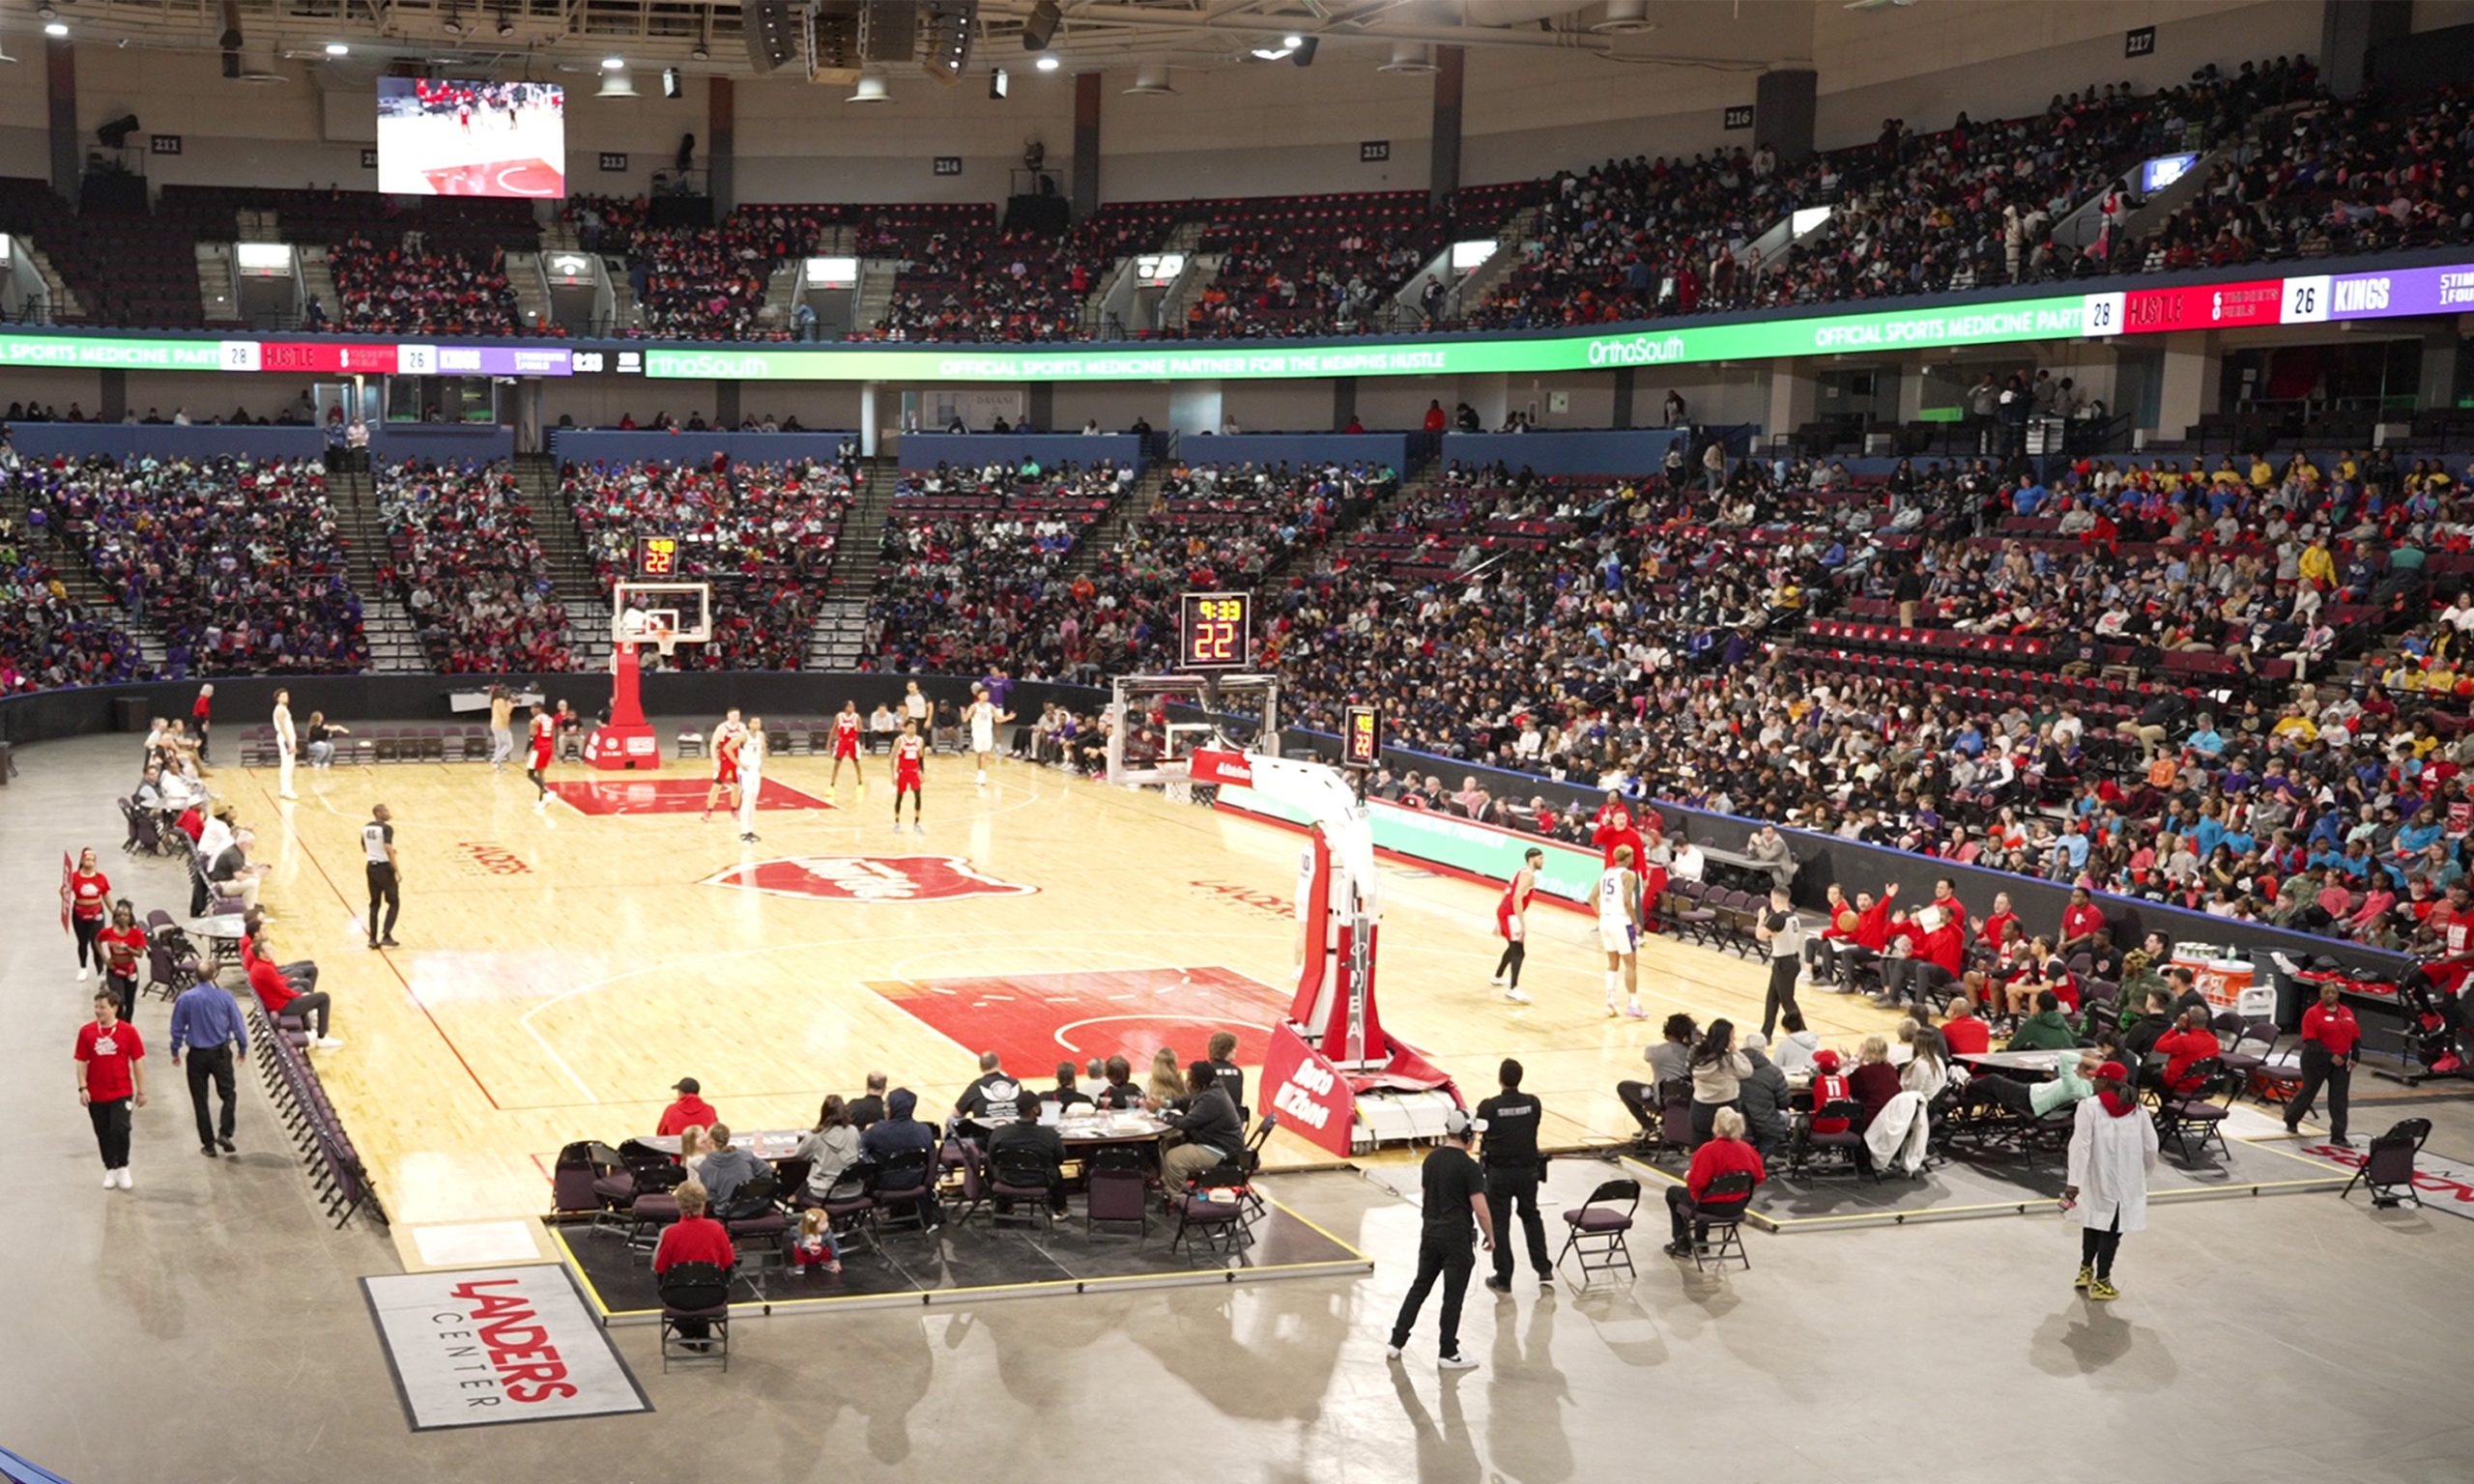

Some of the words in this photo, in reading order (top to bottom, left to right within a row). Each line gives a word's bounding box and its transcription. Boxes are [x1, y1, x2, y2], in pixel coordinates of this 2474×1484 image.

[2128, 33, 2152, 52] 217
[1727, 110, 1750, 125] 216
[155, 138, 178, 151] 211
[1364, 145, 1387, 157] 215
[602, 156, 625, 168] 213
[935, 159, 959, 172] 214
[2295, 288, 2316, 314] 26
[2334, 277, 2391, 312] KINGS
[2093, 302, 2111, 327] 28
[2131, 294, 2184, 326] HUSTLE
[1816, 324, 1882, 347] OFFICIAL
[1886, 318, 1945, 342] SPORTS
[1948, 310, 2033, 337] MEDICINE
[9, 344, 76, 361] SPORTS
[80, 346, 171, 364] MEDICINE
[232, 349, 246, 364] 28
[266, 347, 313, 366] HUSTLE
[410, 352, 424, 368] 26
[1588, 335, 1684, 365] OrthoSouth
[939, 359, 1019, 376] OFFICIAL
[1022, 360, 1081, 375] SPORTS
[1085, 358, 1165, 375] MEDICINE
[1169, 357, 1245, 374] PARTNER
[1250, 357, 1286, 372] FOR
[1289, 355, 1319, 372] THE
[1321, 354, 1387, 371] MEMPHIS
[1390, 352, 1446, 368] HUSTLE
[646, 553, 670, 573] 22
[1199, 600, 1241, 621] 9:33
[1194, 623, 1233, 658] 22
[1355, 734, 1369, 756] 22
[1602, 877, 1615, 896] 15
[1292, 1057, 1335, 1097] Auto
[1826, 1080, 1841, 1097] 11
[1285, 1088, 1330, 1129] Zone
[449, 1278, 579, 1404] LANDERS
[432, 1312, 502, 1408] CENTER
